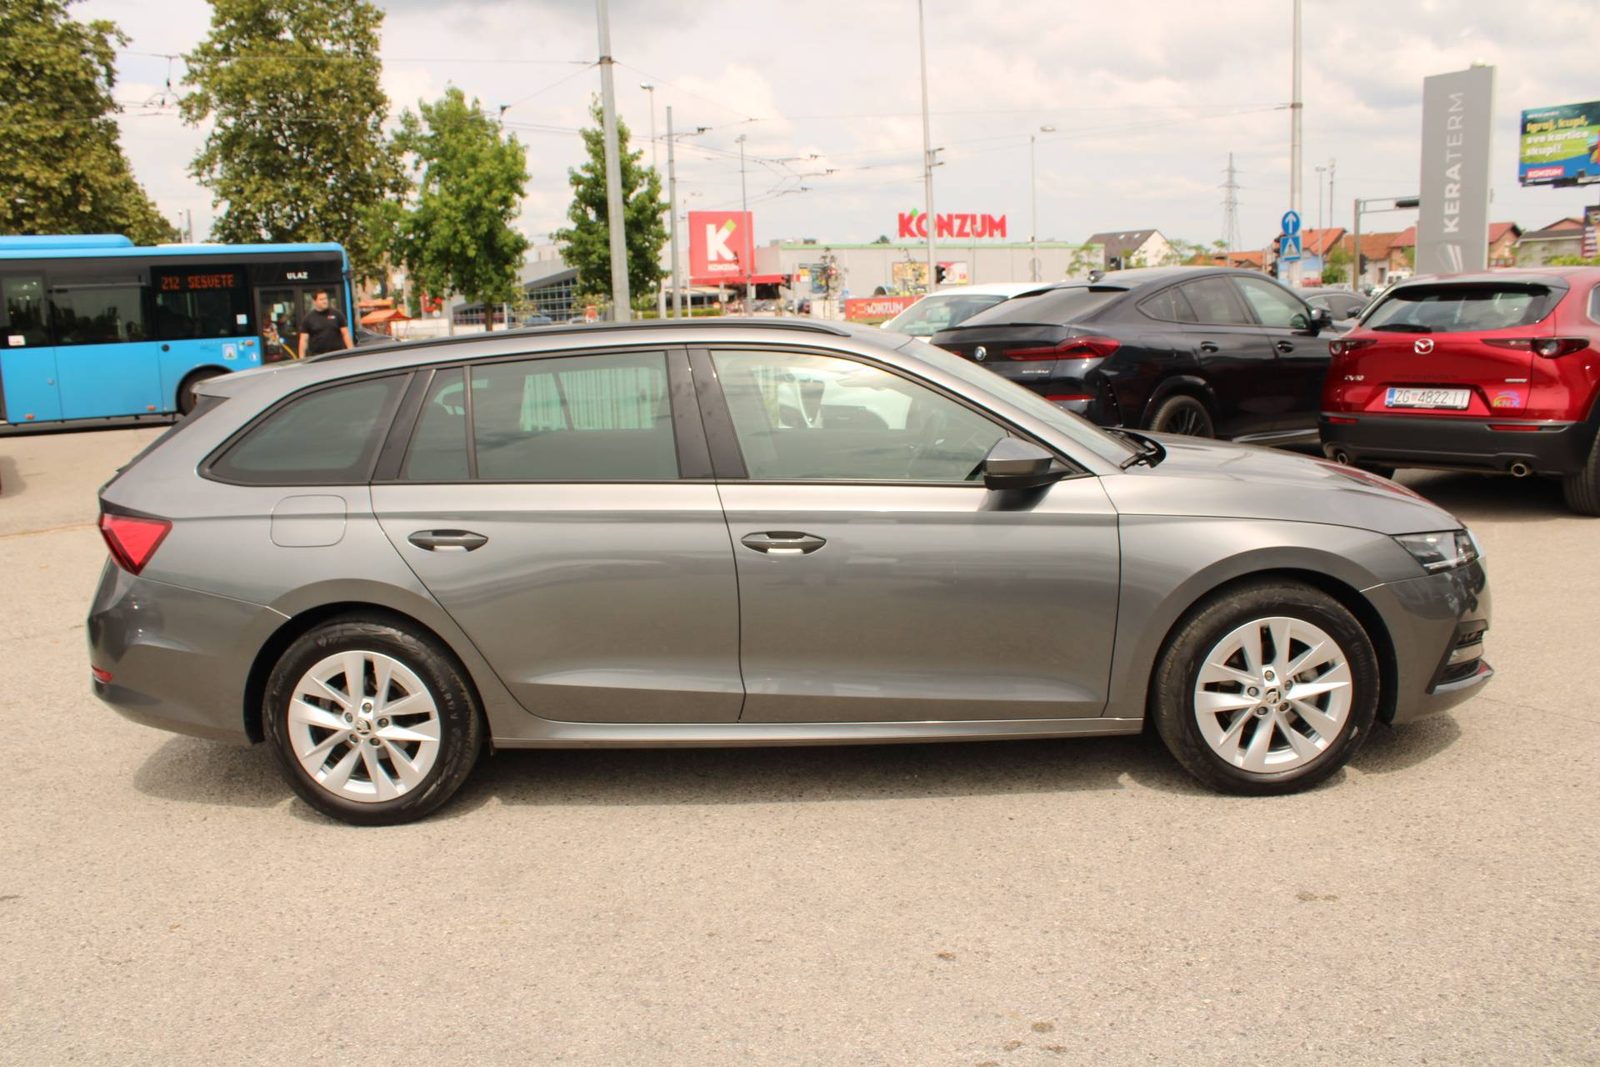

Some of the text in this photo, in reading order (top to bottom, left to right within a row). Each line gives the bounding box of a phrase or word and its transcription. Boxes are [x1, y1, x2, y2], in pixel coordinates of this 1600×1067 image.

[1443, 92, 1464, 233] KERATERM
[898, 208, 1007, 238] KONZUM
[706, 219, 737, 261] K
[161, 275, 180, 290] 212
[1395, 390, 1410, 403] ZG
